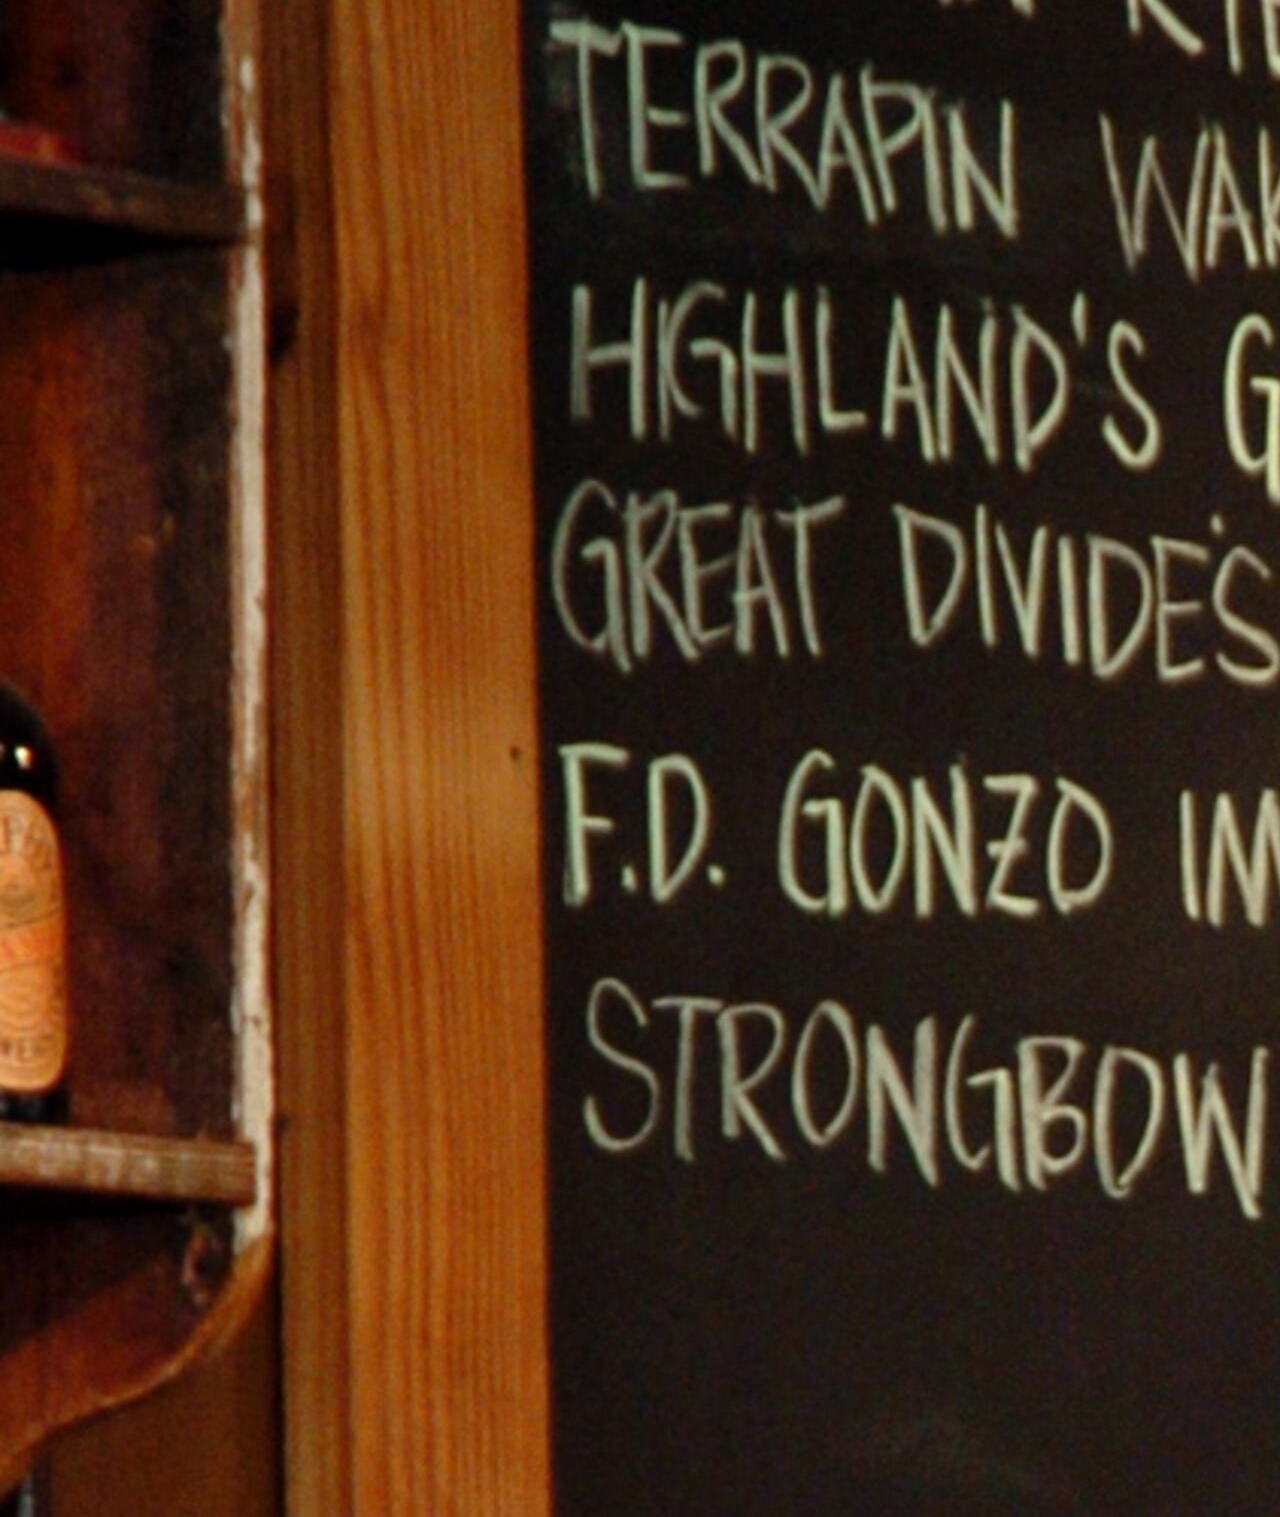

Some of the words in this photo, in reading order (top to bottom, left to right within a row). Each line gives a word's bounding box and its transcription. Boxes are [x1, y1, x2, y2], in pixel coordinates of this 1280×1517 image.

[551, 20, 1019, 238] TERRAPIN
[573, 278, 1161, 471] HIGHLAND'S
[553, 481, 843, 671] GREAT
[560, 743, 725, 903] F.D.
[778, 749, 1113, 918] GONZO
[585, 978, 1269, 1220] STRONGBOW
